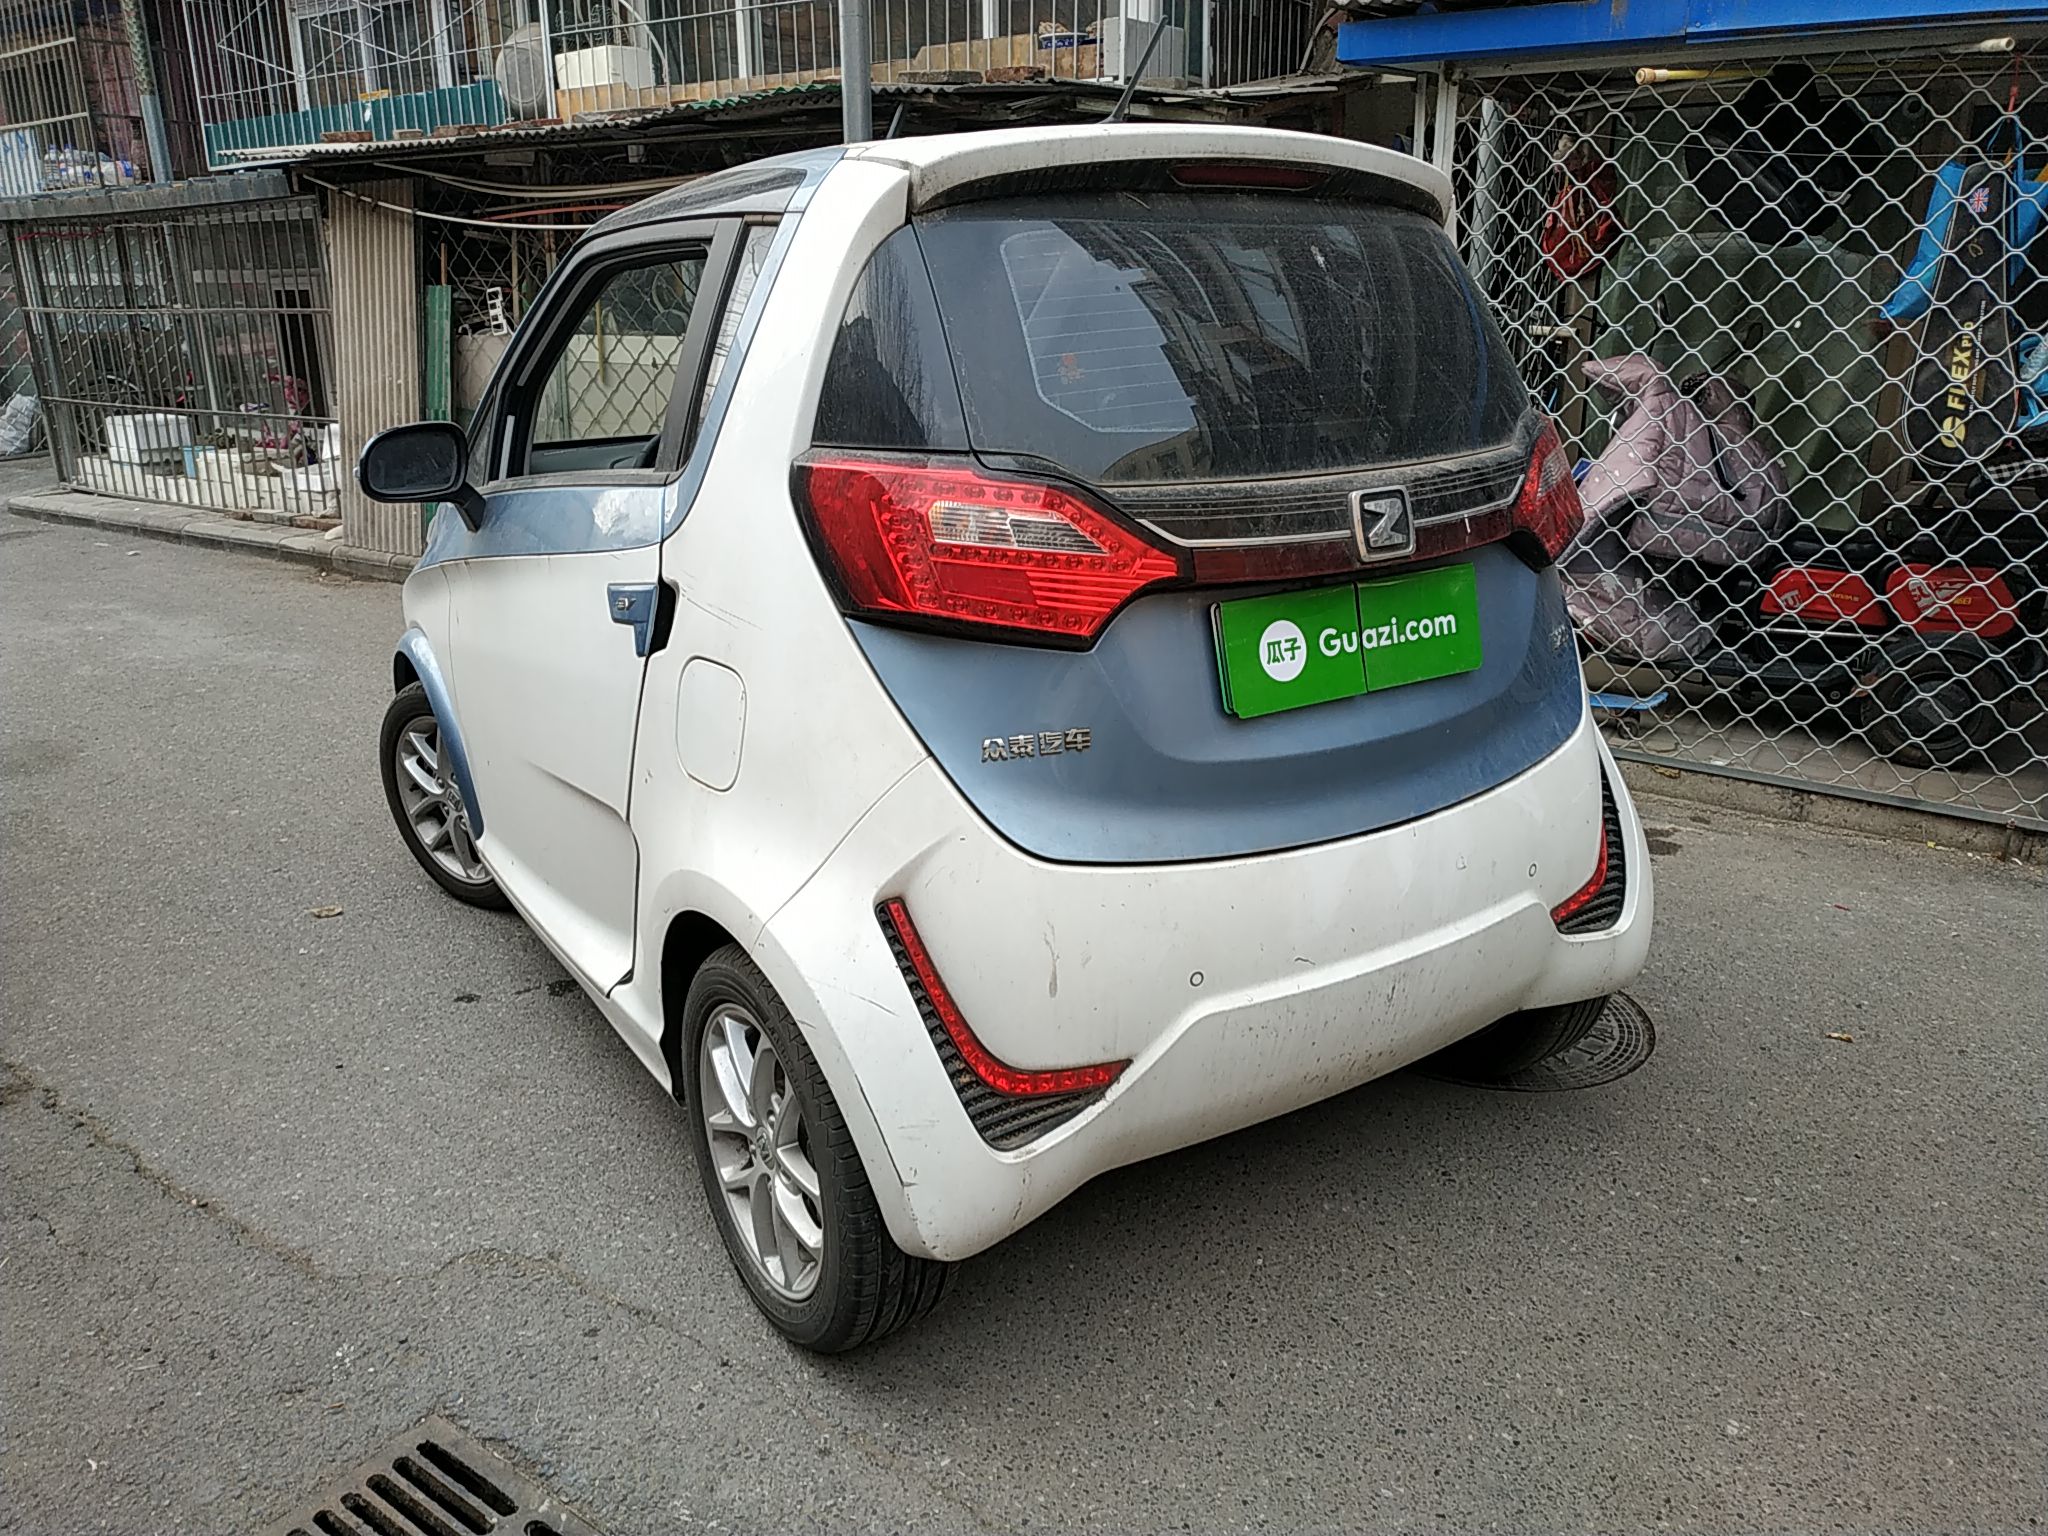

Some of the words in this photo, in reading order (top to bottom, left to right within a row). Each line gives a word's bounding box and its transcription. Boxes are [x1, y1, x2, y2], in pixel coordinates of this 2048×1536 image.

[1266, 637, 1302, 666] 瓜子
[1318, 614, 1457, 657] Guazi.com
[981, 728, 1092, 762] 众泰汽车
